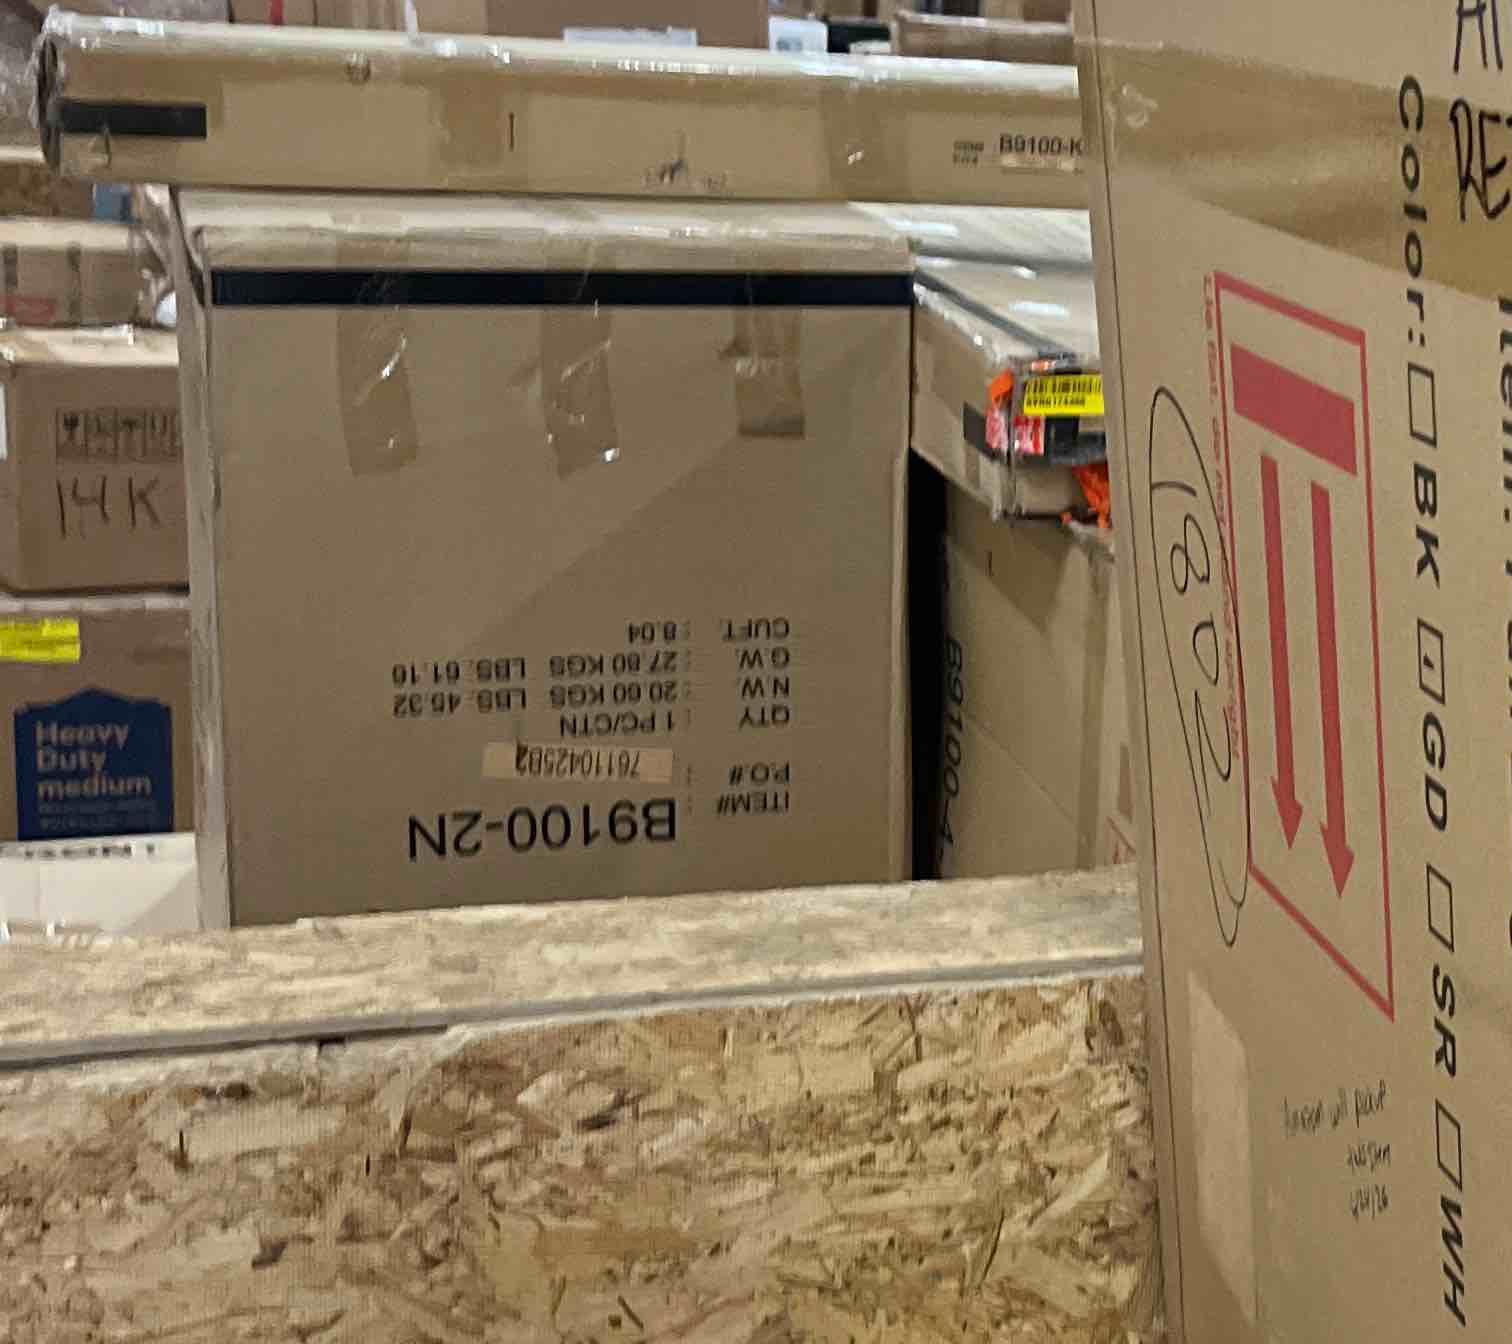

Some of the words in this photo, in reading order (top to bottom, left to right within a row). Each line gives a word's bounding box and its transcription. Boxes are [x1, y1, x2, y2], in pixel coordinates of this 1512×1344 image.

[1398, 74, 1429, 350] Color:
[1412, 460, 1442, 591] BK
[36, 720, 129, 750] Heavy
[36, 747, 107, 773] Duty
[738, 704, 790, 729] QTY
[36, 775, 152, 801] medium
[1422, 709, 1448, 833] GD
[406, 796, 678, 863] B9100-2N
[1429, 962, 1458, 1080] SR
[1437, 1190, 1467, 1329] WH
